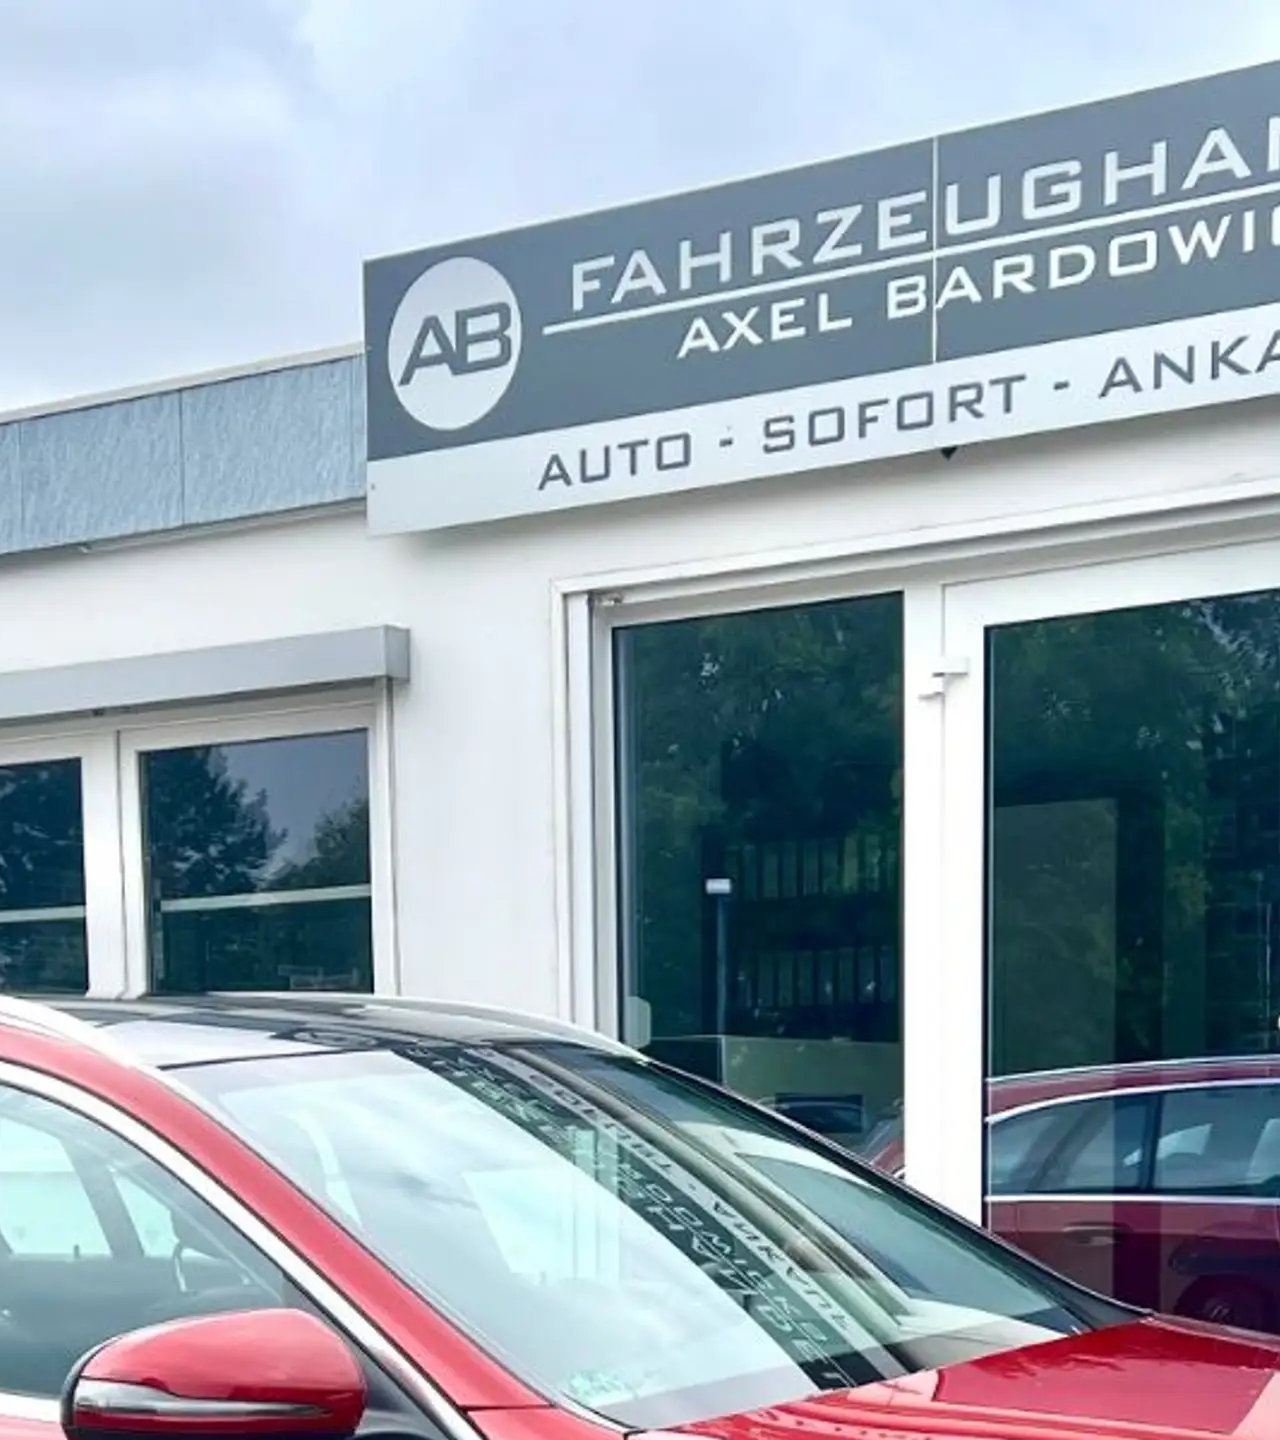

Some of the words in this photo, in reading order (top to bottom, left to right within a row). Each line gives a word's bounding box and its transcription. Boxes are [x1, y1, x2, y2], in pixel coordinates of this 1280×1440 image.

[400, 303, 512, 386] AB
[676, 291, 851, 360] AXEL
[538, 432, 692, 490] AUTO
[764, 376, 1027, 454] SOFORT
